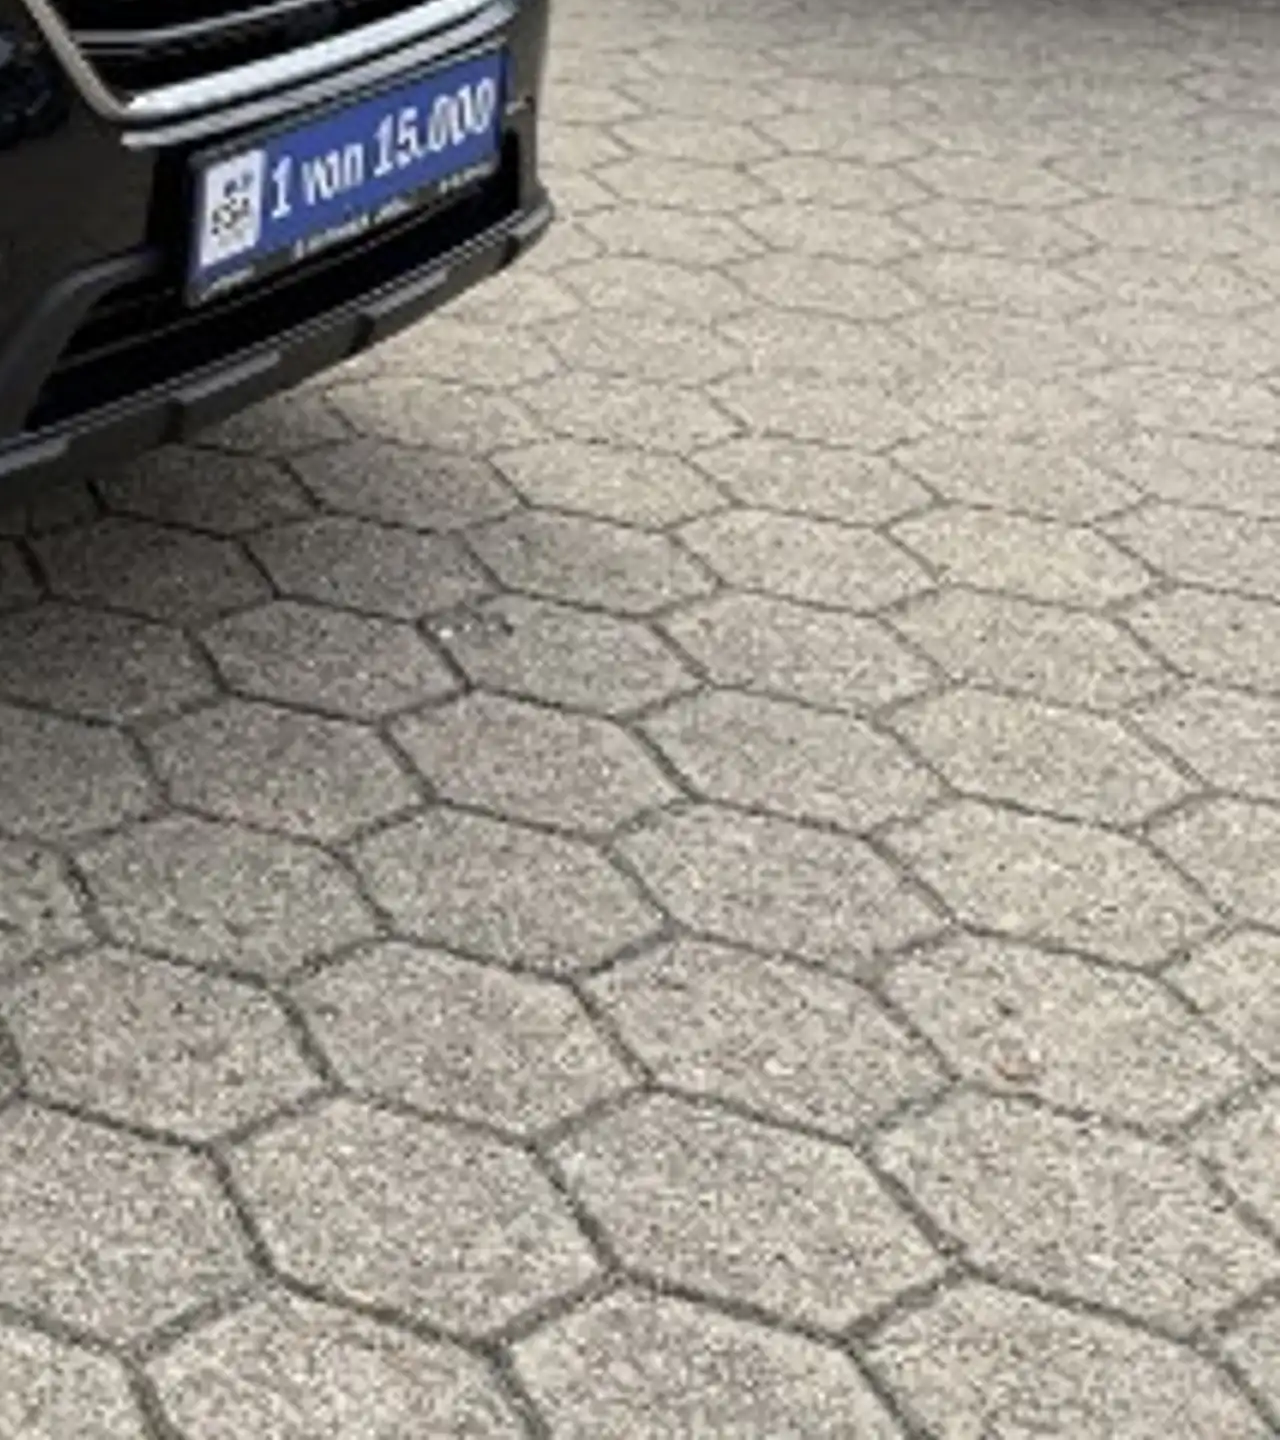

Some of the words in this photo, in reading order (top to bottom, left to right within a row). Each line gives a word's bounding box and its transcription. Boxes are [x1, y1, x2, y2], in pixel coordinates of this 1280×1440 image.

[270, 155, 292, 220] 1
[301, 142, 365, 206] von
[372, 76, 496, 178] 15.000
